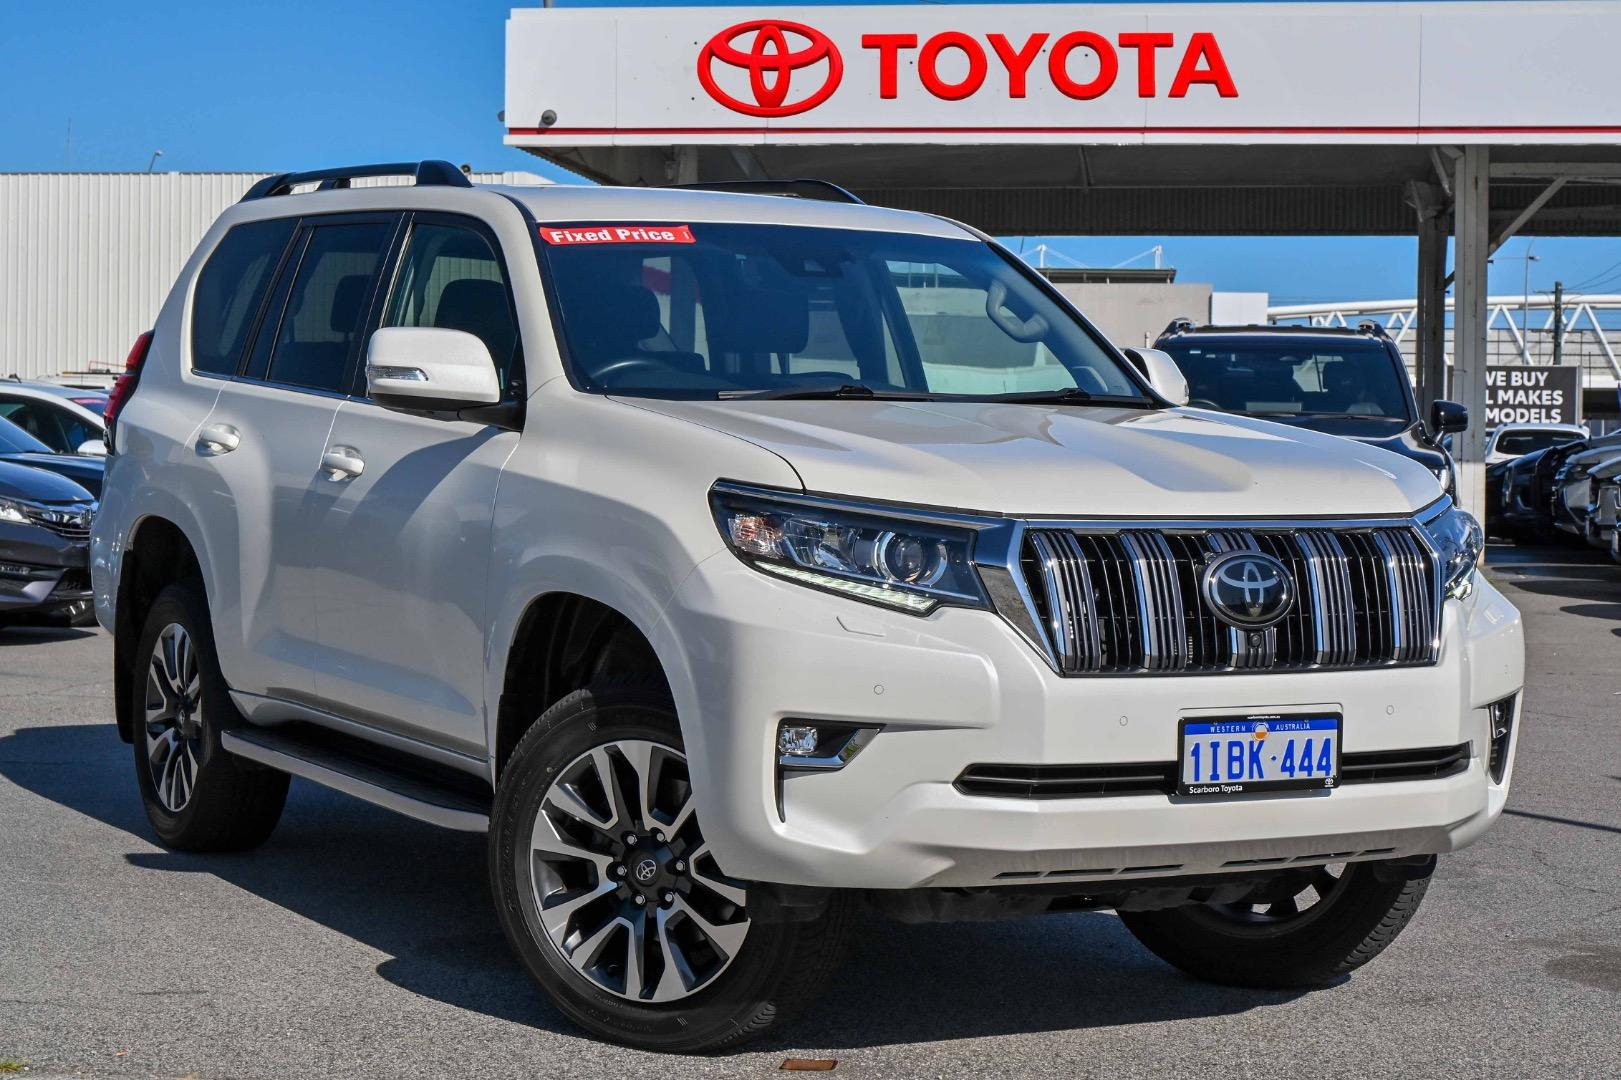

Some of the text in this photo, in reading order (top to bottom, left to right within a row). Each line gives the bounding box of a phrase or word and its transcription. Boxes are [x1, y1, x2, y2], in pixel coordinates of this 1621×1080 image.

[861, 31, 1239, 101] TOYOTA
[550, 228, 676, 243] Fixed Price
[1510, 371, 1549, 387] BUY
[1497, 389, 1564, 405] MAKES
[1485, 407, 1562, 424] MODELS
[1209, 723, 1311, 733] WESTERN AUSTRALIA
[1189, 783, 1243, 794] Scarboro Toyota
